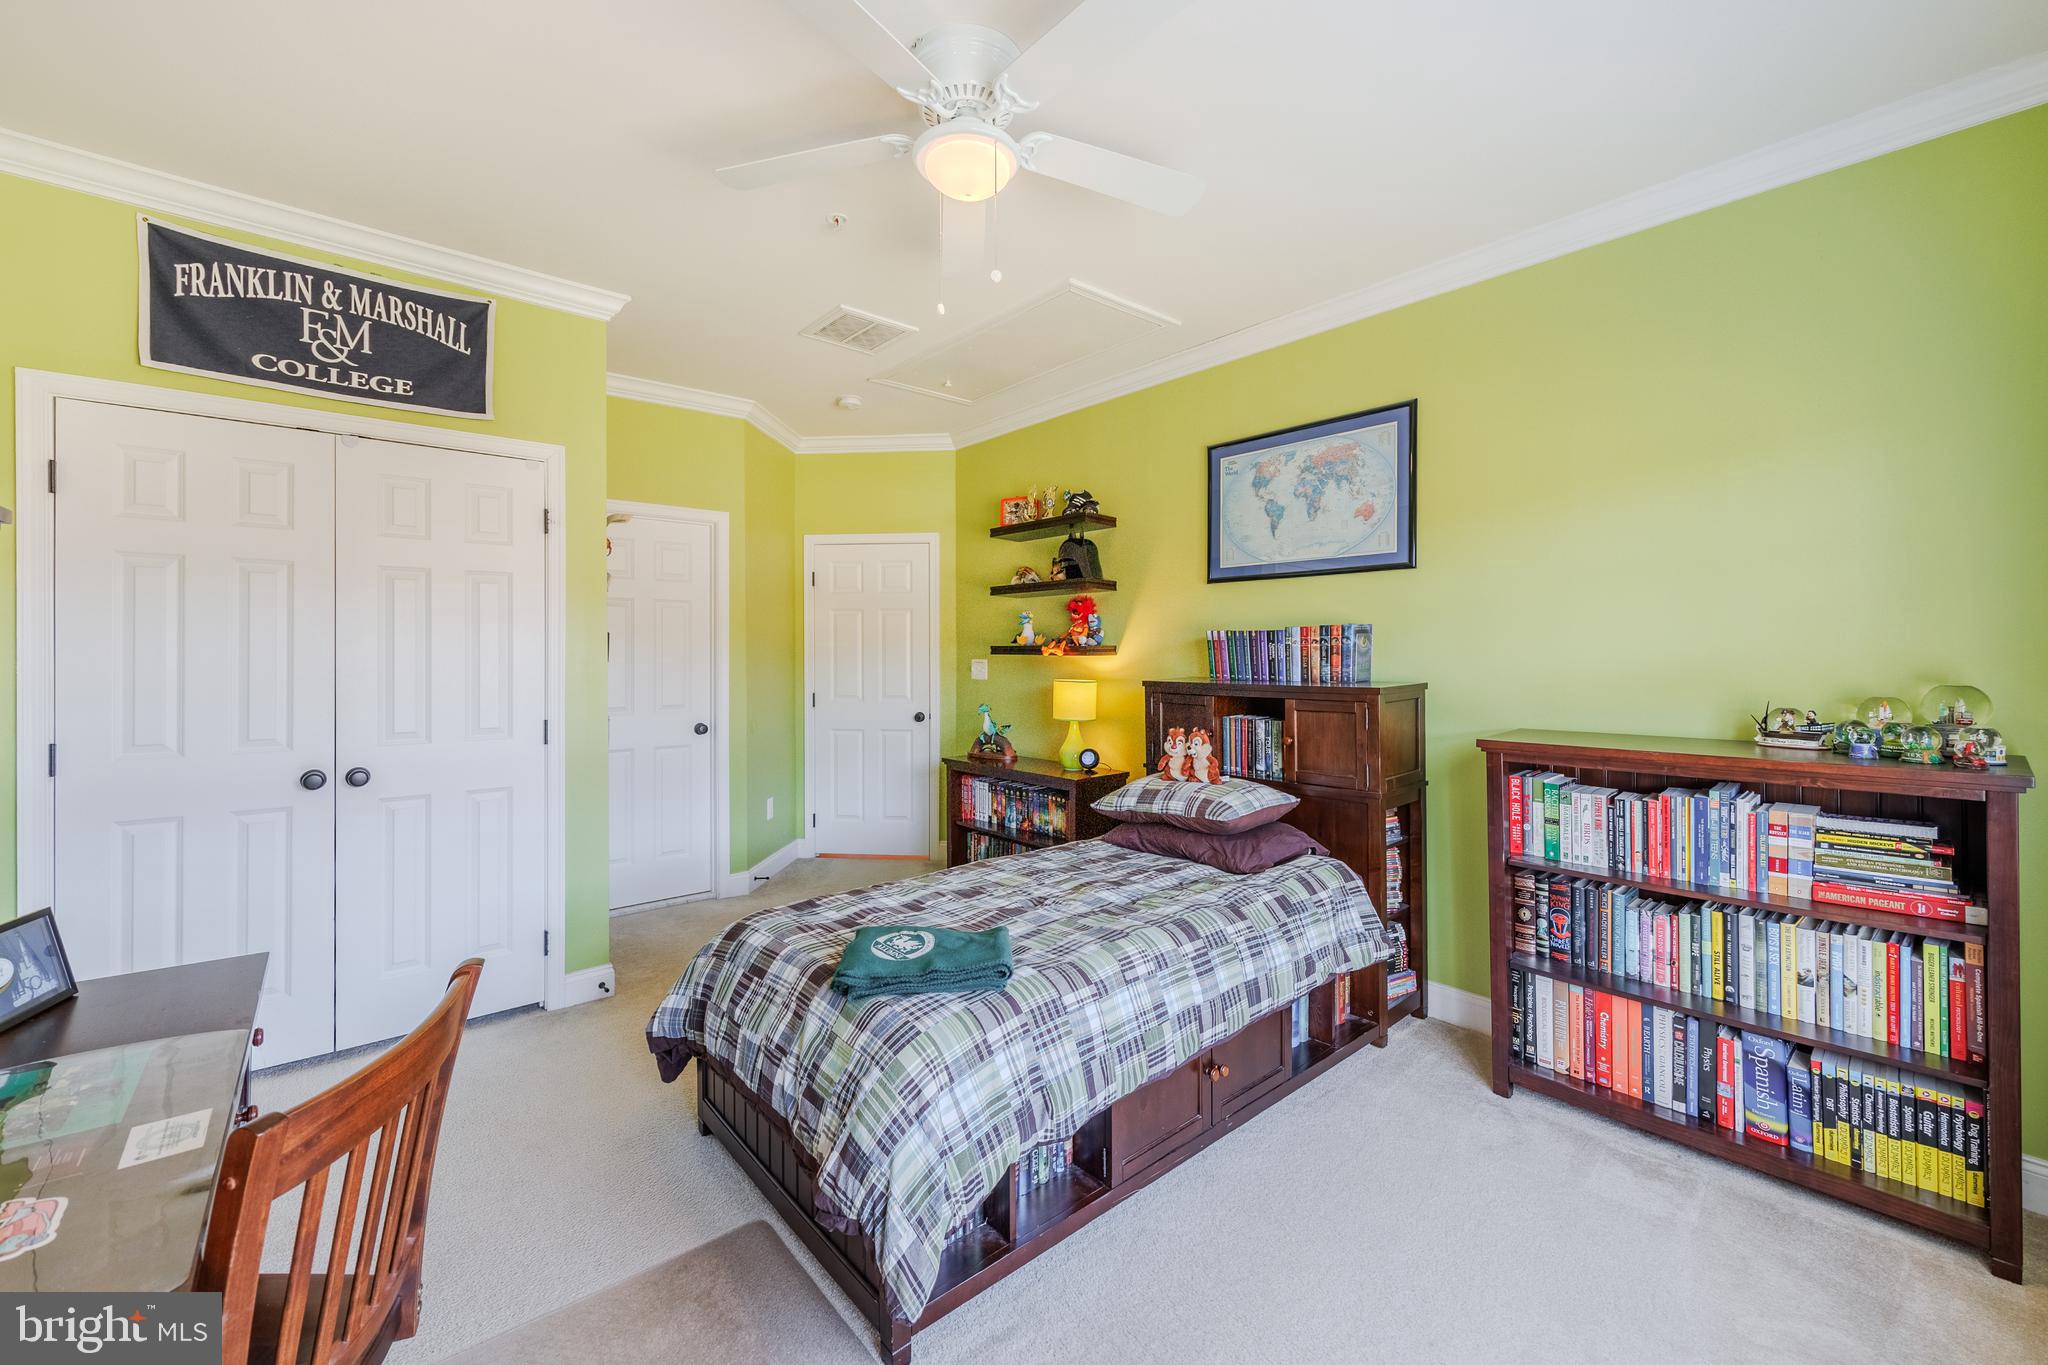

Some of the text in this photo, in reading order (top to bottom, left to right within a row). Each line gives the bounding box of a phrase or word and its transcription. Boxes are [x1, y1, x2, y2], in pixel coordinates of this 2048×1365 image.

[174, 262, 471, 355] FRANKLIN & MARSHALL
[251, 353, 414, 396] COLLEGE
[1511, 778, 1521, 821] BLACK HOLE
[1544, 788, 1552, 816] CARSON
[1550, 901, 1570, 910] KING
[1825, 892, 1866, 905] AMERICAN
[1868, 899, 1905, 910] PAGEANT
[1550, 934, 1569, 944] THREE
[1769, 928, 1778, 945] BOYS
[1819, 936, 1827, 956] JUNGLE
[1769, 953, 1778, 966] SEX
[1874, 970, 1883, 1011] indistractable
[1556, 1000, 1566, 1041] PSYCHOLOGY
[1598, 1012, 1609, 1050] Chemistry
[1748, 1034, 1774, 1047] Oxford
[1701, 1047, 1712, 1072] Physics
[1748, 1045, 1778, 1110] Spanish
[1791, 1077, 1807, 1108] Latin
[1826, 1098, 1834, 1111] DBT
[1838, 1083, 1848, 1119] Philosophy
[1851, 1097, 1859, 1125] Statistics
[1864, 1093, 1873, 1125] Chemistry
[1889, 1098, 1898, 1137] Biostatistics
[1903, 1106, 1913, 1132] Spanish
[1923, 1111, 1934, 1136] Guitar
[1940, 1112, 1949, 1146] Harmonica
[1750, 1127, 1780, 1140] OXFORD
[1840, 1127, 1848, 1156] DUMMIES
[1953, 1114, 1964, 1152] Psychology
[1968, 1123, 1979, 1165] Dog Training
[1890, 1144, 1898, 1174] DUMMIES
[1904, 1146, 1912, 1176] DUMMIES
[1922, 1151, 1931, 1181] DUMMIES
[1941, 1156, 1950, 1184] DUMMIES
[1956, 1160, 1964, 1191] DUMMIES
